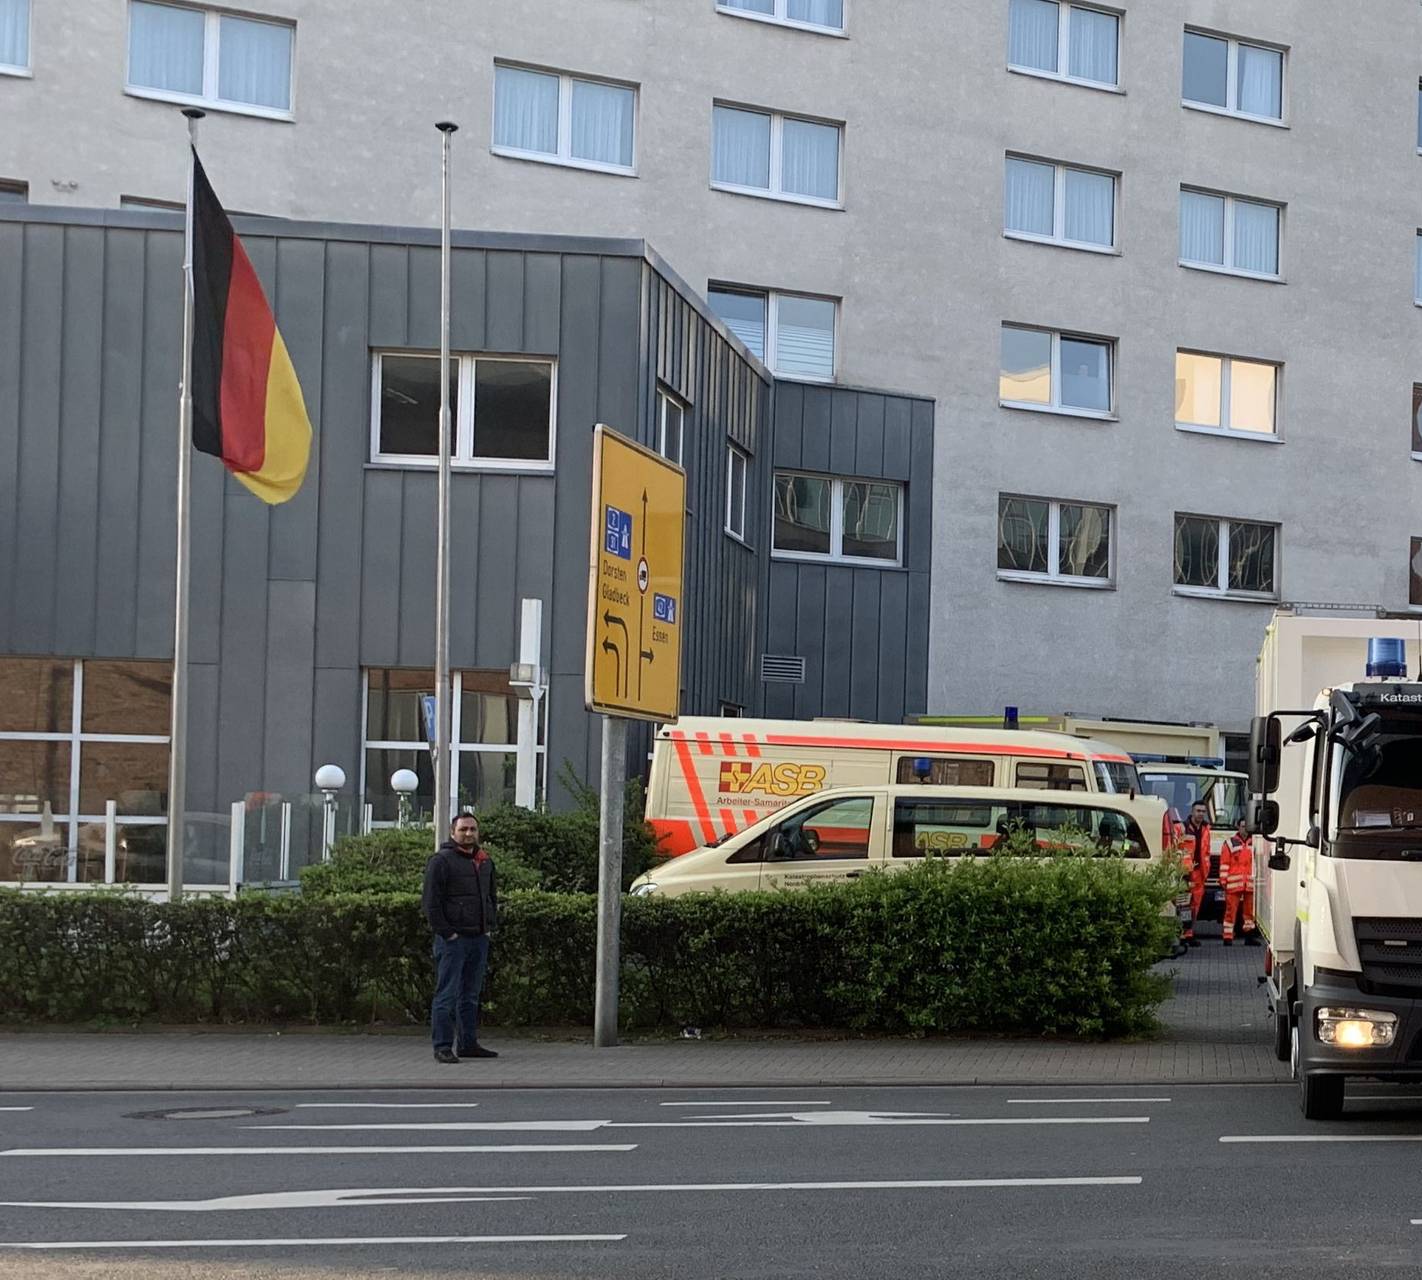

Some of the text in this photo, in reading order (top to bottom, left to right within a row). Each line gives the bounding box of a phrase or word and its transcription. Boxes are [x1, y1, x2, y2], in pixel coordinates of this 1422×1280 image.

[603, 560, 627, 582] Dorsten
[602, 583, 630, 607] Gladbeck
[652, 626, 669, 643] Essen
[740, 762, 827, 797] ASB
